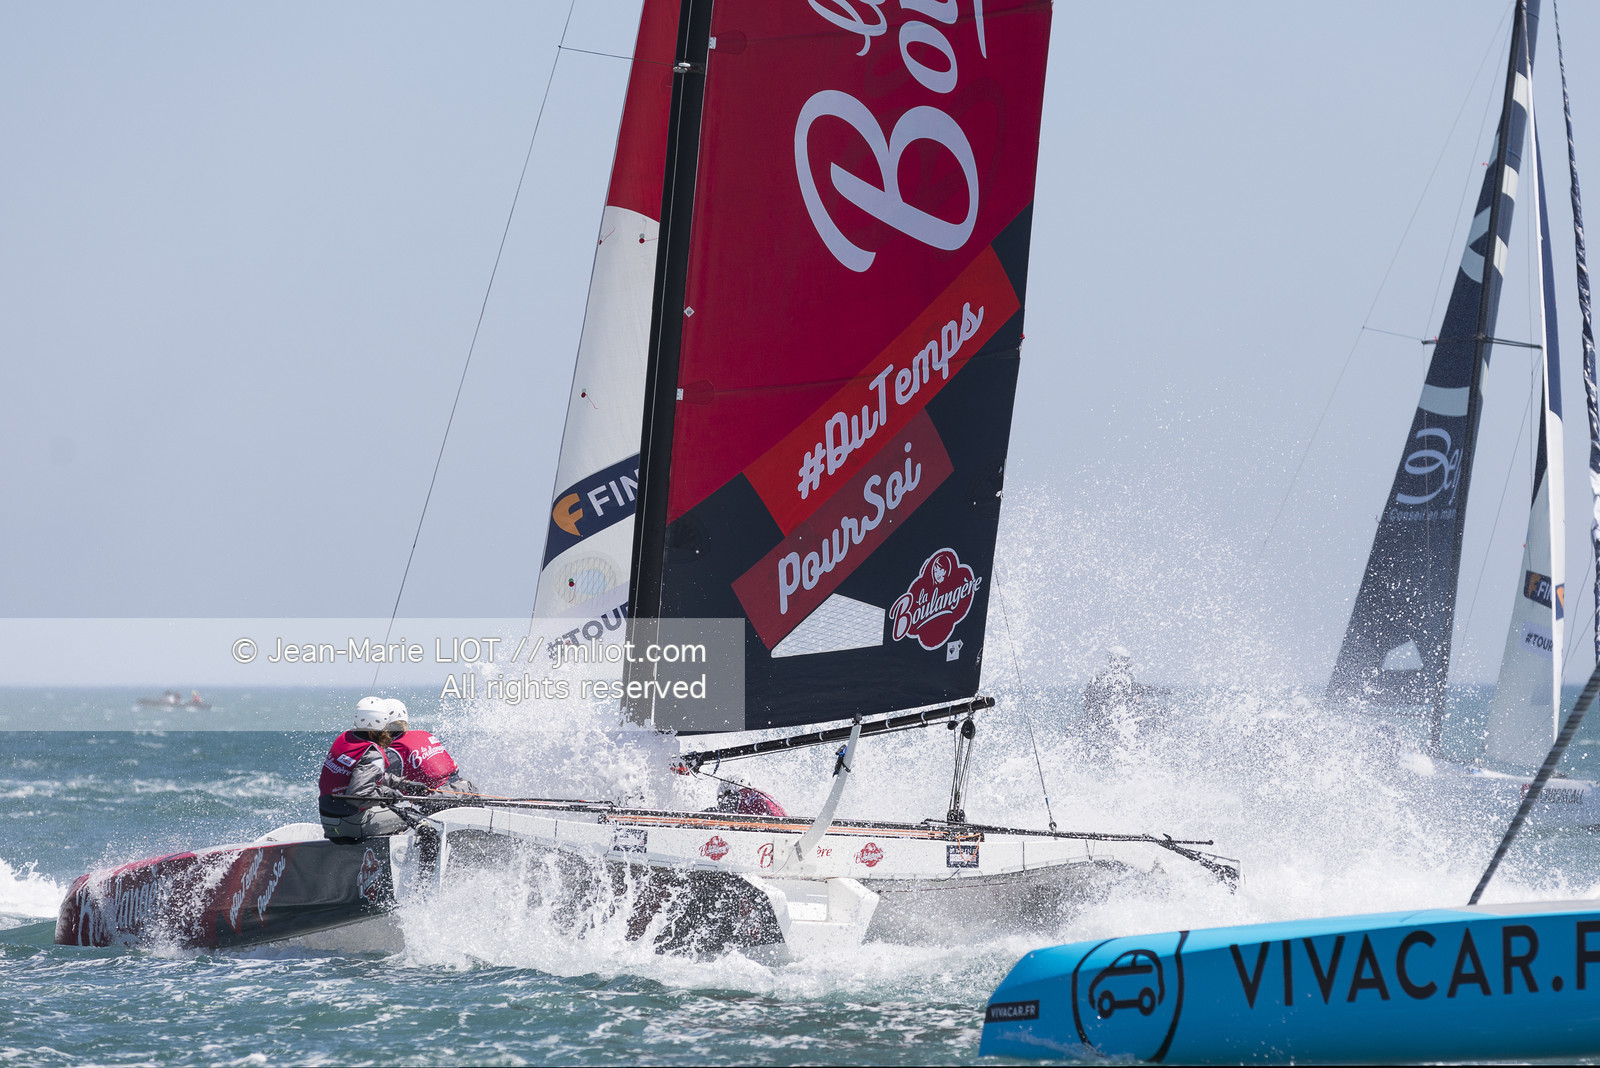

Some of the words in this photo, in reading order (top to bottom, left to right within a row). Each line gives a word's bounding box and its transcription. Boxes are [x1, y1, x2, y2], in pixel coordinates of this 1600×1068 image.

[797, 302, 984, 500] #DuTemps
[889, 576, 982, 641] Boulangère
[916, 588, 928, 606] la
[990, 1004, 1036, 1018] VIVACAR.FR
